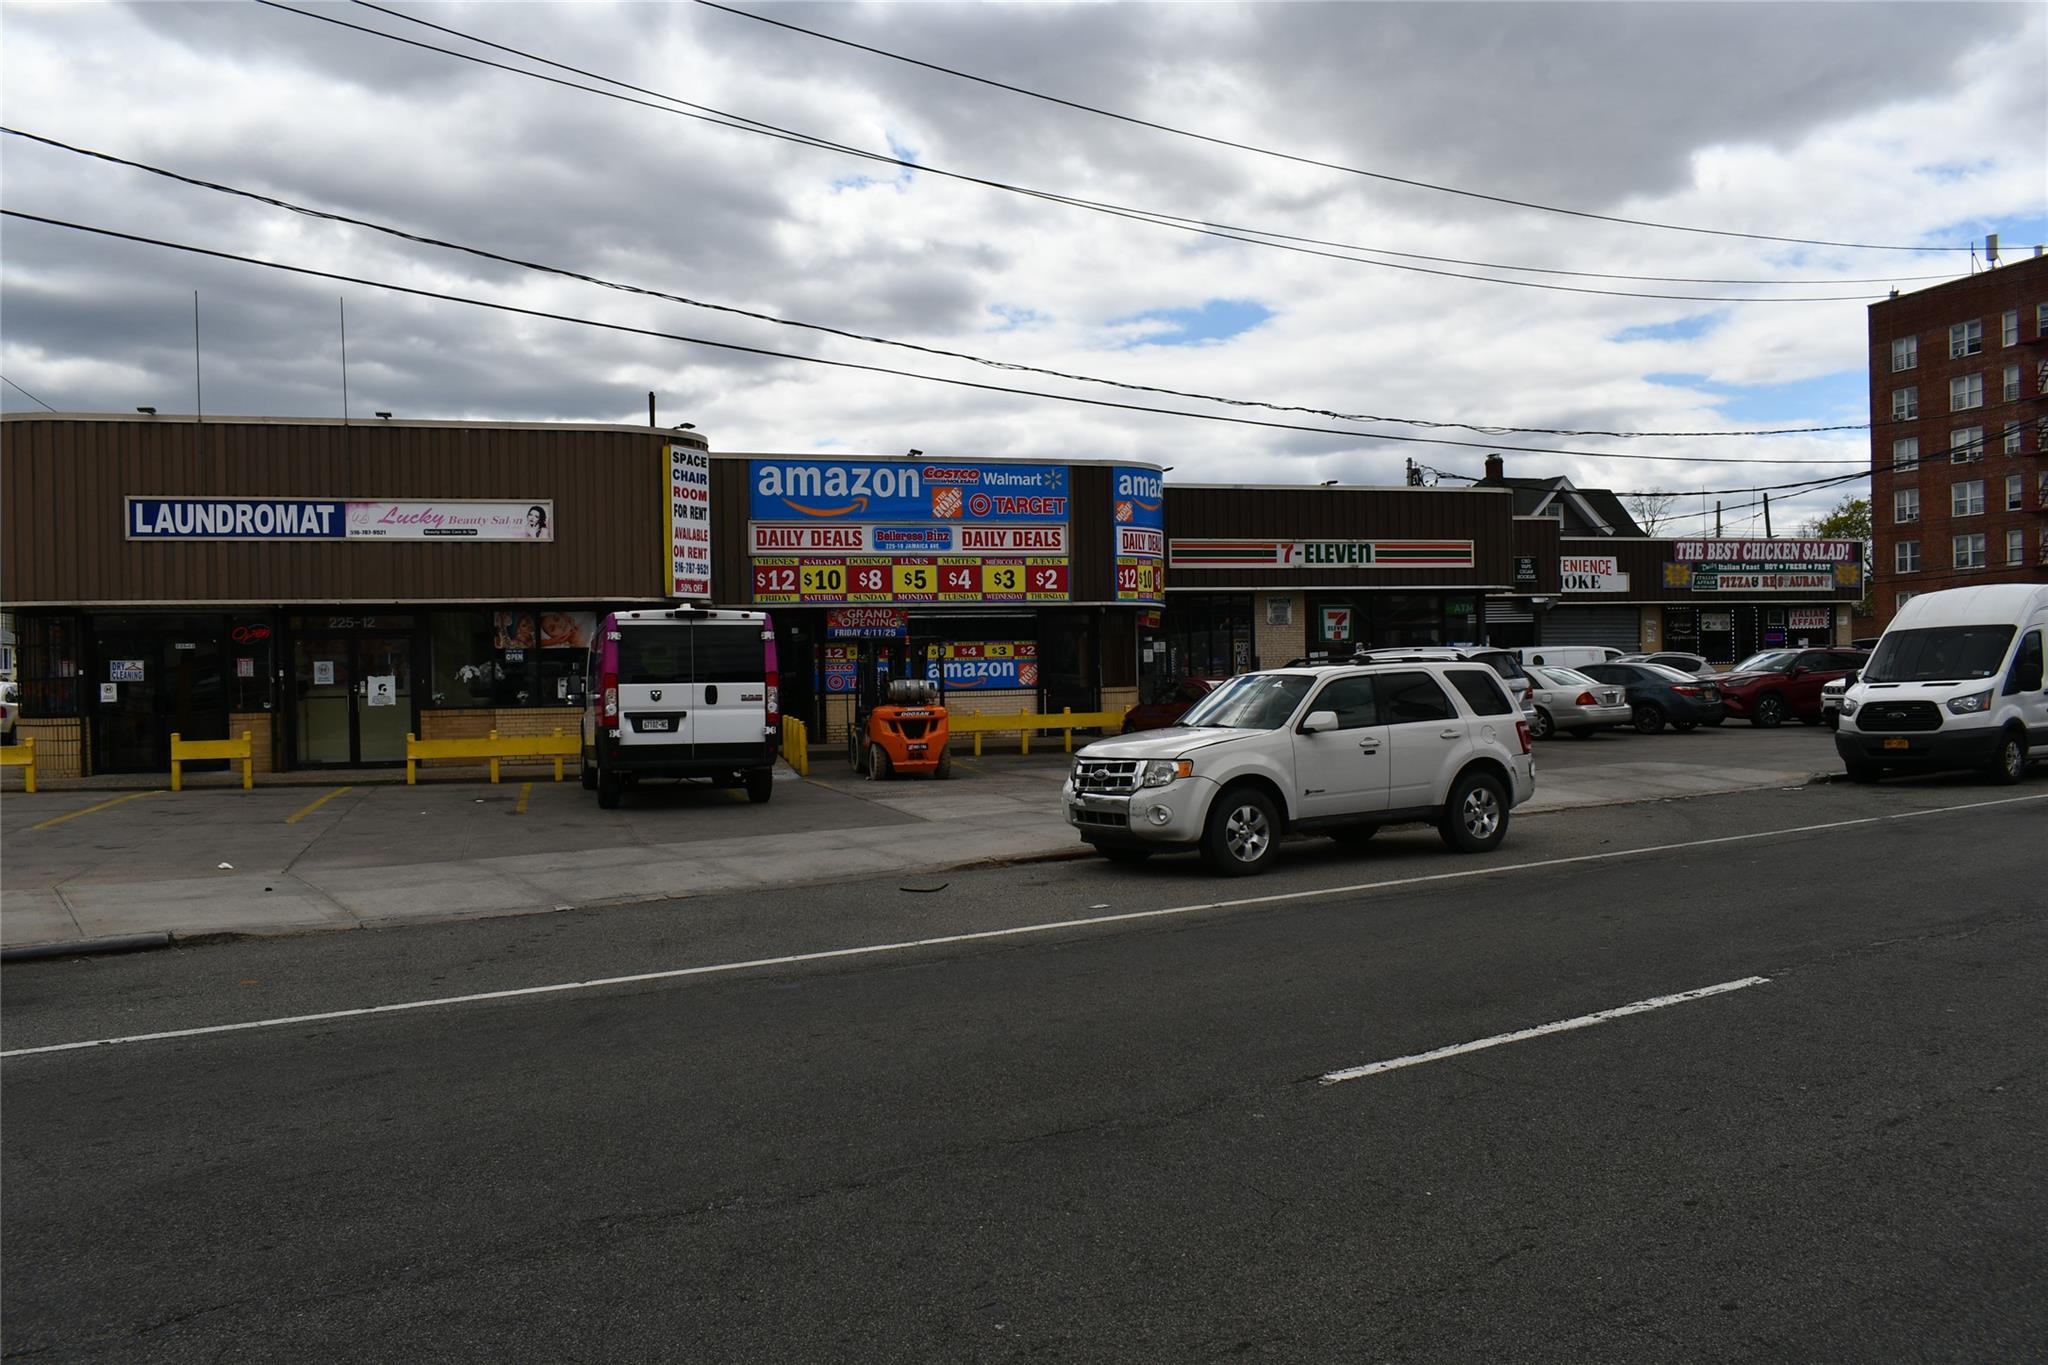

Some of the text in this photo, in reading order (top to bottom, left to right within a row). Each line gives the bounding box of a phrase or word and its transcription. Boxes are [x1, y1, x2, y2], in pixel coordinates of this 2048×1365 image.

[673, 451, 707, 468] SPACE
[673, 468, 707, 485] CHAIR
[923, 466, 980, 479] COSTCO
[983, 472, 1042, 486] Walmart
[758, 465, 920, 498] amazon
[673, 486, 707, 502] ROOM
[932, 487, 962, 518] HOME
[993, 496, 1067, 515] TARGET
[135, 502, 335, 534] LAUNDROMAT
[377, 506, 444, 528] Lucky
[674, 503, 707, 520] FOR RENT
[448, 515, 488, 527] Beauty
[675, 526, 708, 542] AVAILABLE
[757, 530, 862, 547] DAILY DEALS
[926, 529, 949, 541] Binz
[962, 531, 1061, 547] DAILY DEALS
[1122, 532, 1146, 550] DAILY
[673, 545, 708, 560] ON RENT
[1676, 543, 1849, 560] THE BEST CHICKEN SALAD!
[900, 557, 929, 565] LUNES
[756, 569, 796, 591] $12
[803, 569, 841, 590] $10
[859, 569, 883, 591] $8
[904, 569, 927, 590] $5
[949, 569, 972, 590] $4
[994, 569, 1015, 589] $3
[1035, 569, 1058, 590] $2
[1118, 568, 1136, 589] $12
[1139, 569, 1153, 589] $10
[1762, 575, 1830, 588] RESTAURANT
[693, 584, 704, 593] OFF
[846, 608, 893, 618] GRAND
[1791, 609, 1825, 617] ITALIAN
[328, 616, 376, 628] 225-12
[841, 617, 898, 627] OPENING
[1791, 618, 1825, 626] AFFAIR
[834, 629, 896, 637] FRIDAY 4/11/25
[505, 653, 523, 662] OPEN
[961, 646, 977, 656] $4
[991, 646, 1007, 656] $3
[1020, 646, 1036, 655] $2
[112, 661, 126, 671] DRY
[928, 661, 1015, 679] amazon
[112, 671, 143, 680] CLEANING
